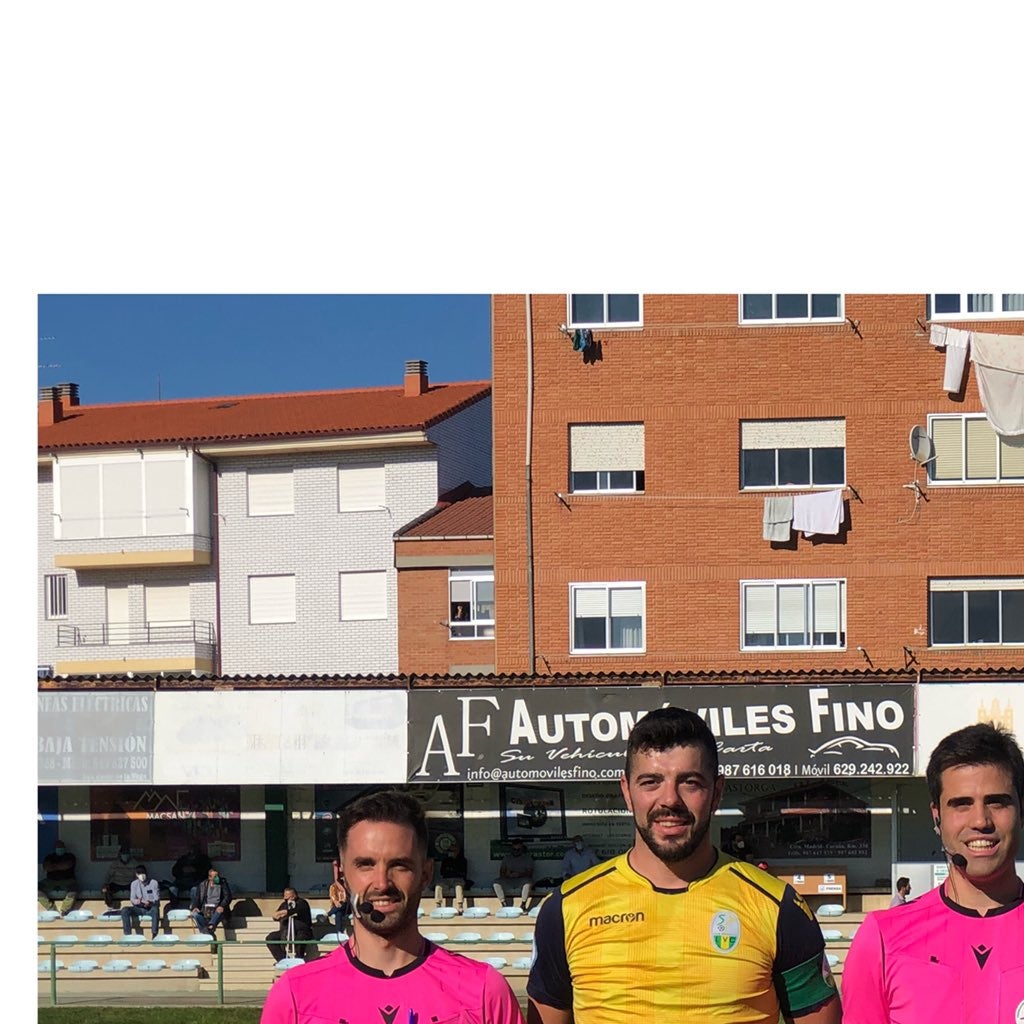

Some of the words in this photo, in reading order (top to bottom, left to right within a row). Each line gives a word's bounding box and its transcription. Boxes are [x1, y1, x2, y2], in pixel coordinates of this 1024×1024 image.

[509, 699, 797, 745] AUTOMILES
[808, 688, 904, 733] FINO
[467, 766, 625, 781] info@automovilesfino.com
[742, 764, 766, 776] 616
[768, 763, 791, 775] 018
[801, 763, 830, 775] Móvil
[833, 762, 910, 775] 629.242.922
[589, 911, 645, 927] macron
